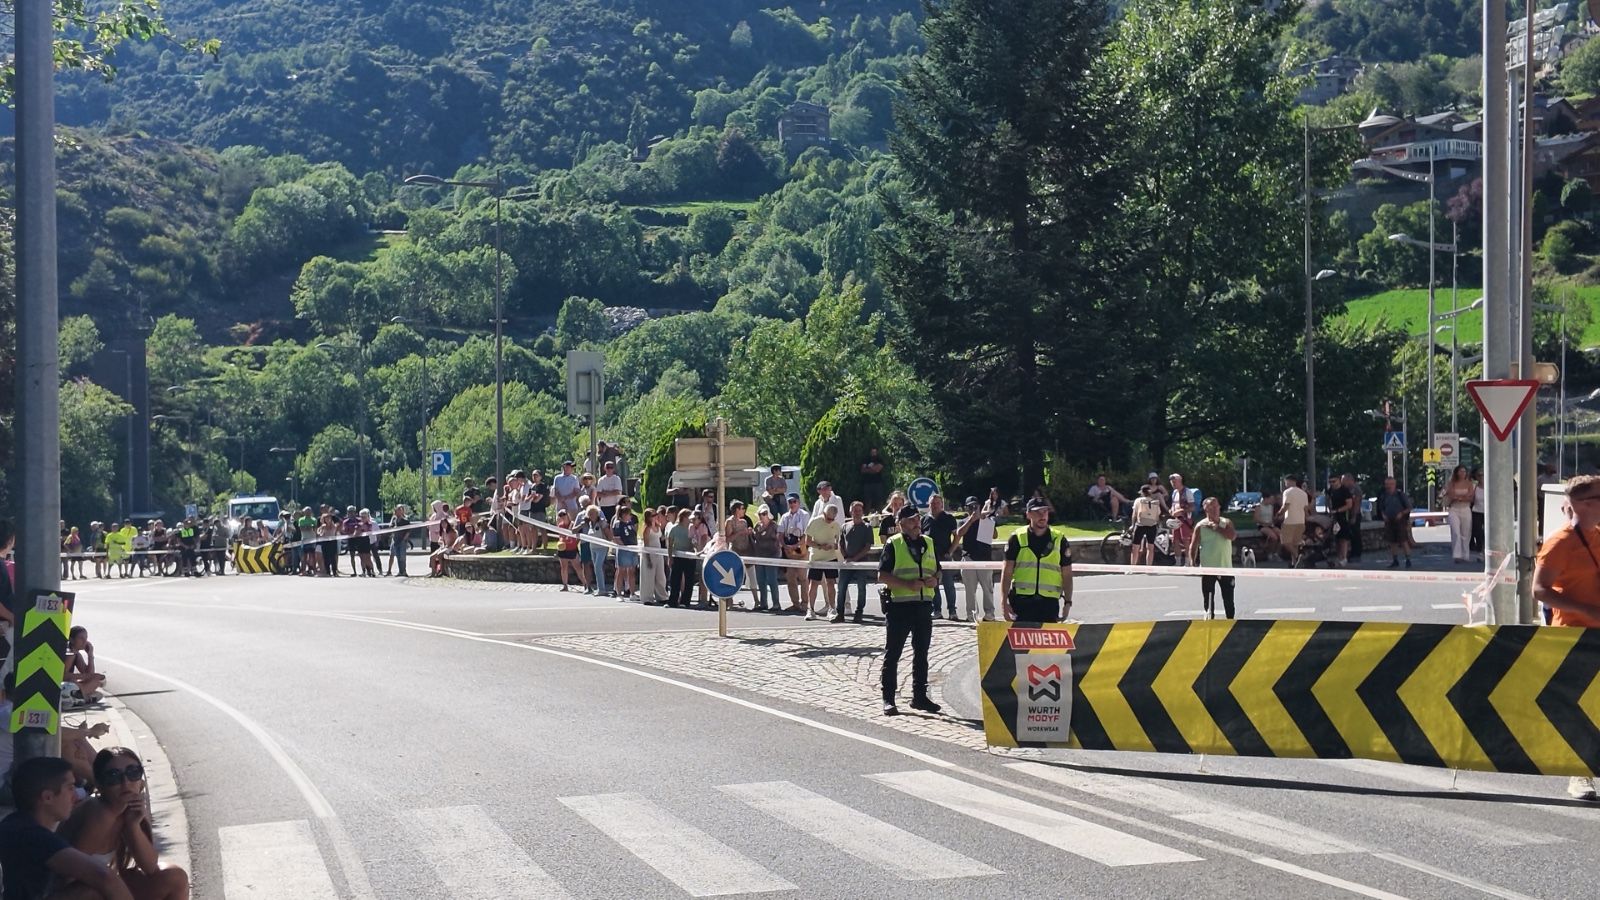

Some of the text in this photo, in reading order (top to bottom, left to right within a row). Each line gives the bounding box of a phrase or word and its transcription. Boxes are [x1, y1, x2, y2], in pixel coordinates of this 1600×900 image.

[434, 454, 444, 471] P
[1014, 632, 1068, 646] LA VUELTA
[1027, 714, 1060, 722] MODYF
